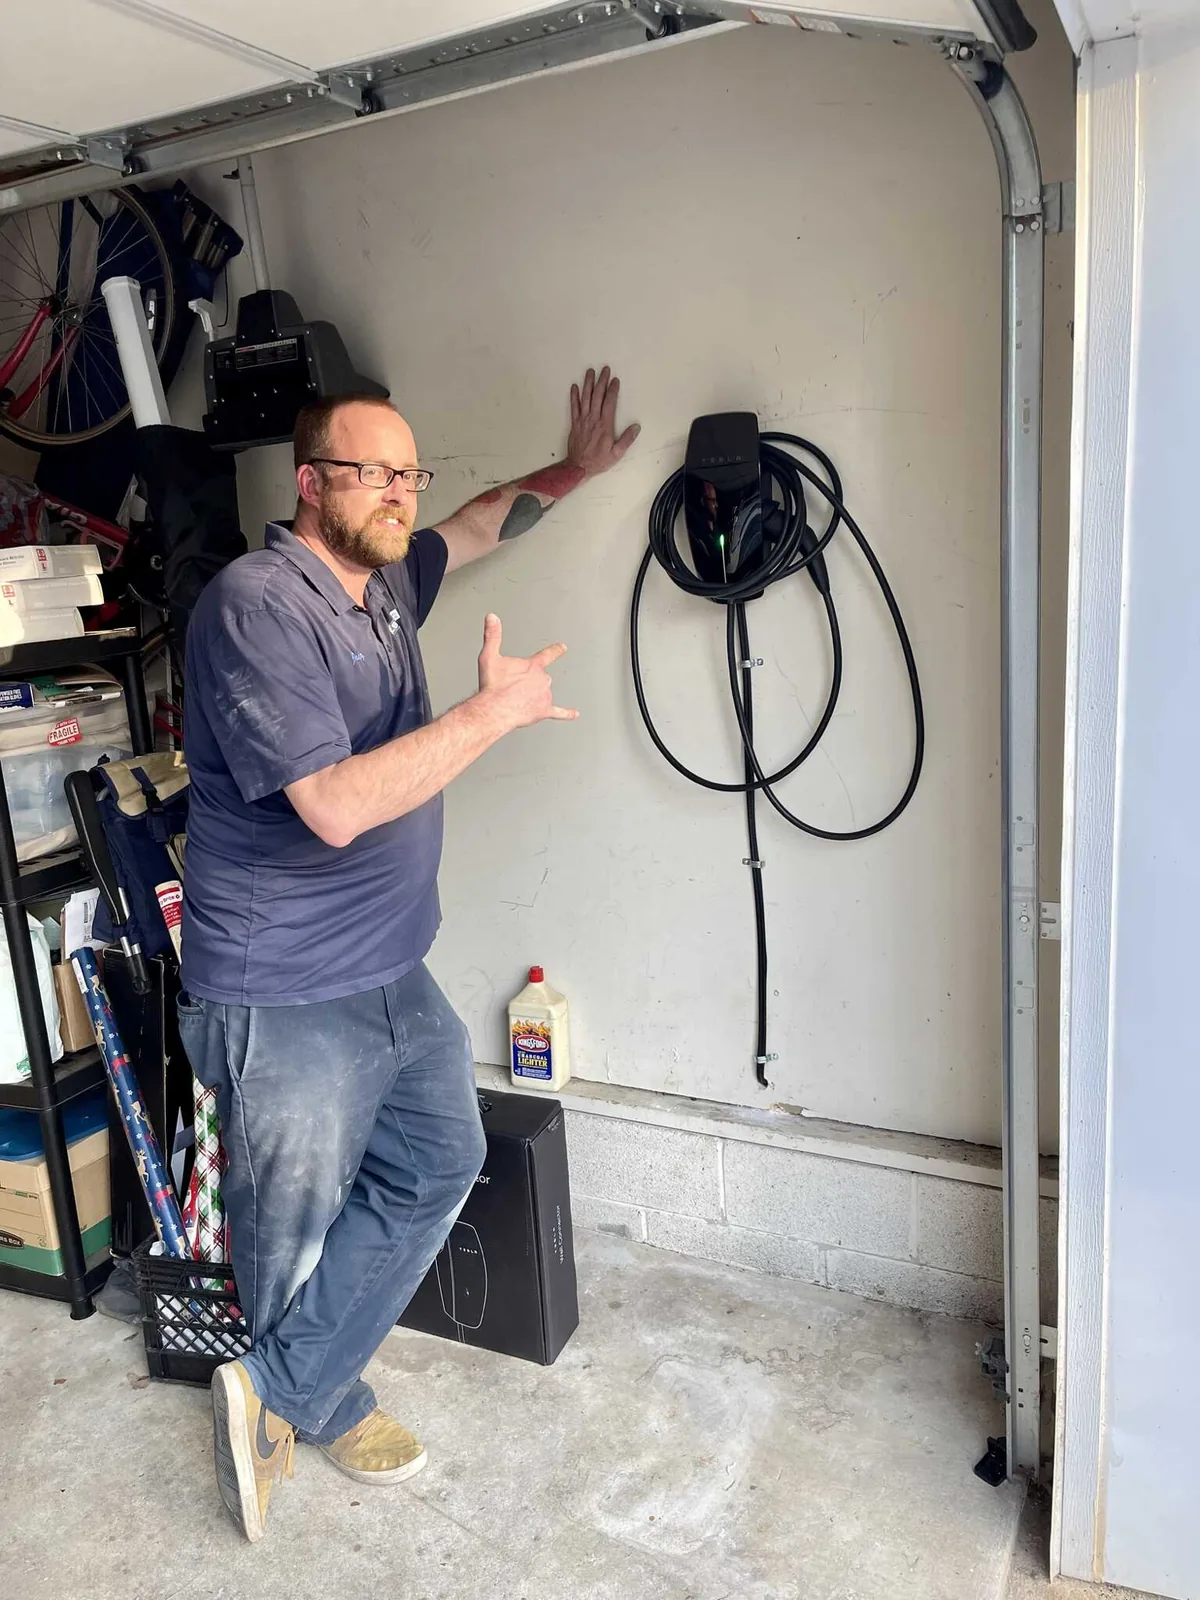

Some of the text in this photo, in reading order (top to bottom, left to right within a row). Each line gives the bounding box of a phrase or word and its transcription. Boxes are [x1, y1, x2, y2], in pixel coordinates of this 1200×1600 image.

[701, 455, 742, 463] TESLA
[49, 724, 78, 741] FRAGILE
[517, 1053, 548, 1061] CHARCOAL
[517, 1057, 548, 1068] LIGHTER
